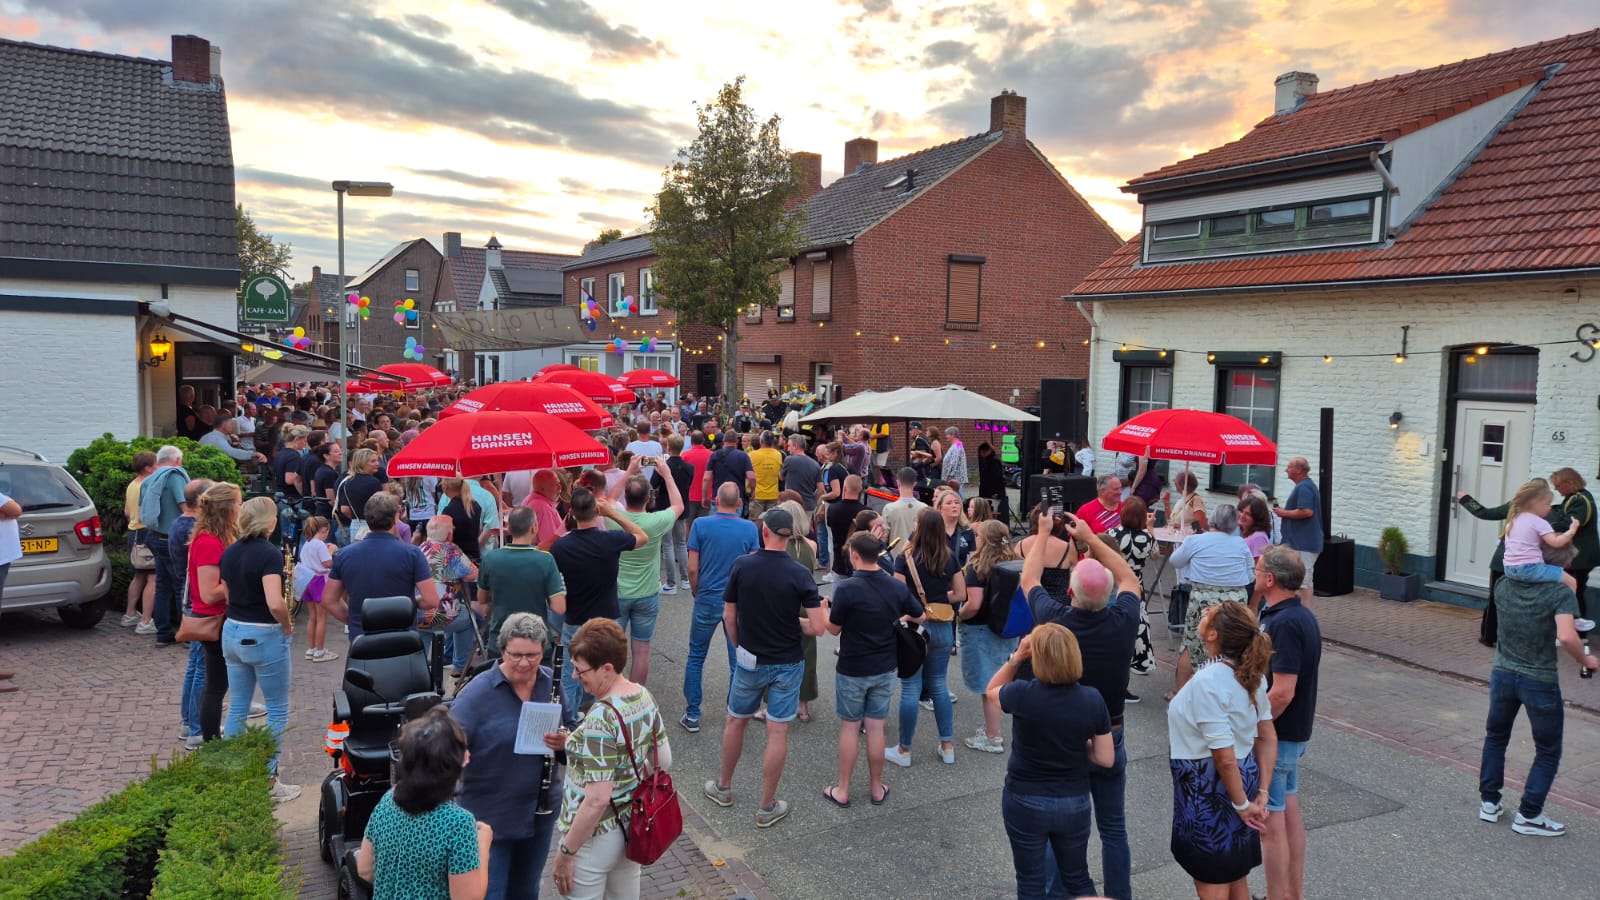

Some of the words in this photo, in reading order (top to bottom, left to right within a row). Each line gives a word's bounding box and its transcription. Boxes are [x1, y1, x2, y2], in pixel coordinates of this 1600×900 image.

[471, 432, 532, 443] HANSEN
[1551, 431, 1566, 441] 65
[471, 440, 533, 450] DRANKEN
[559, 453, 580, 461] HANSEN
[1184, 450, 1217, 459] DRANKEN
[397, 463, 421, 471] HANSEN
[422, 463, 454, 471] DRANKEN
